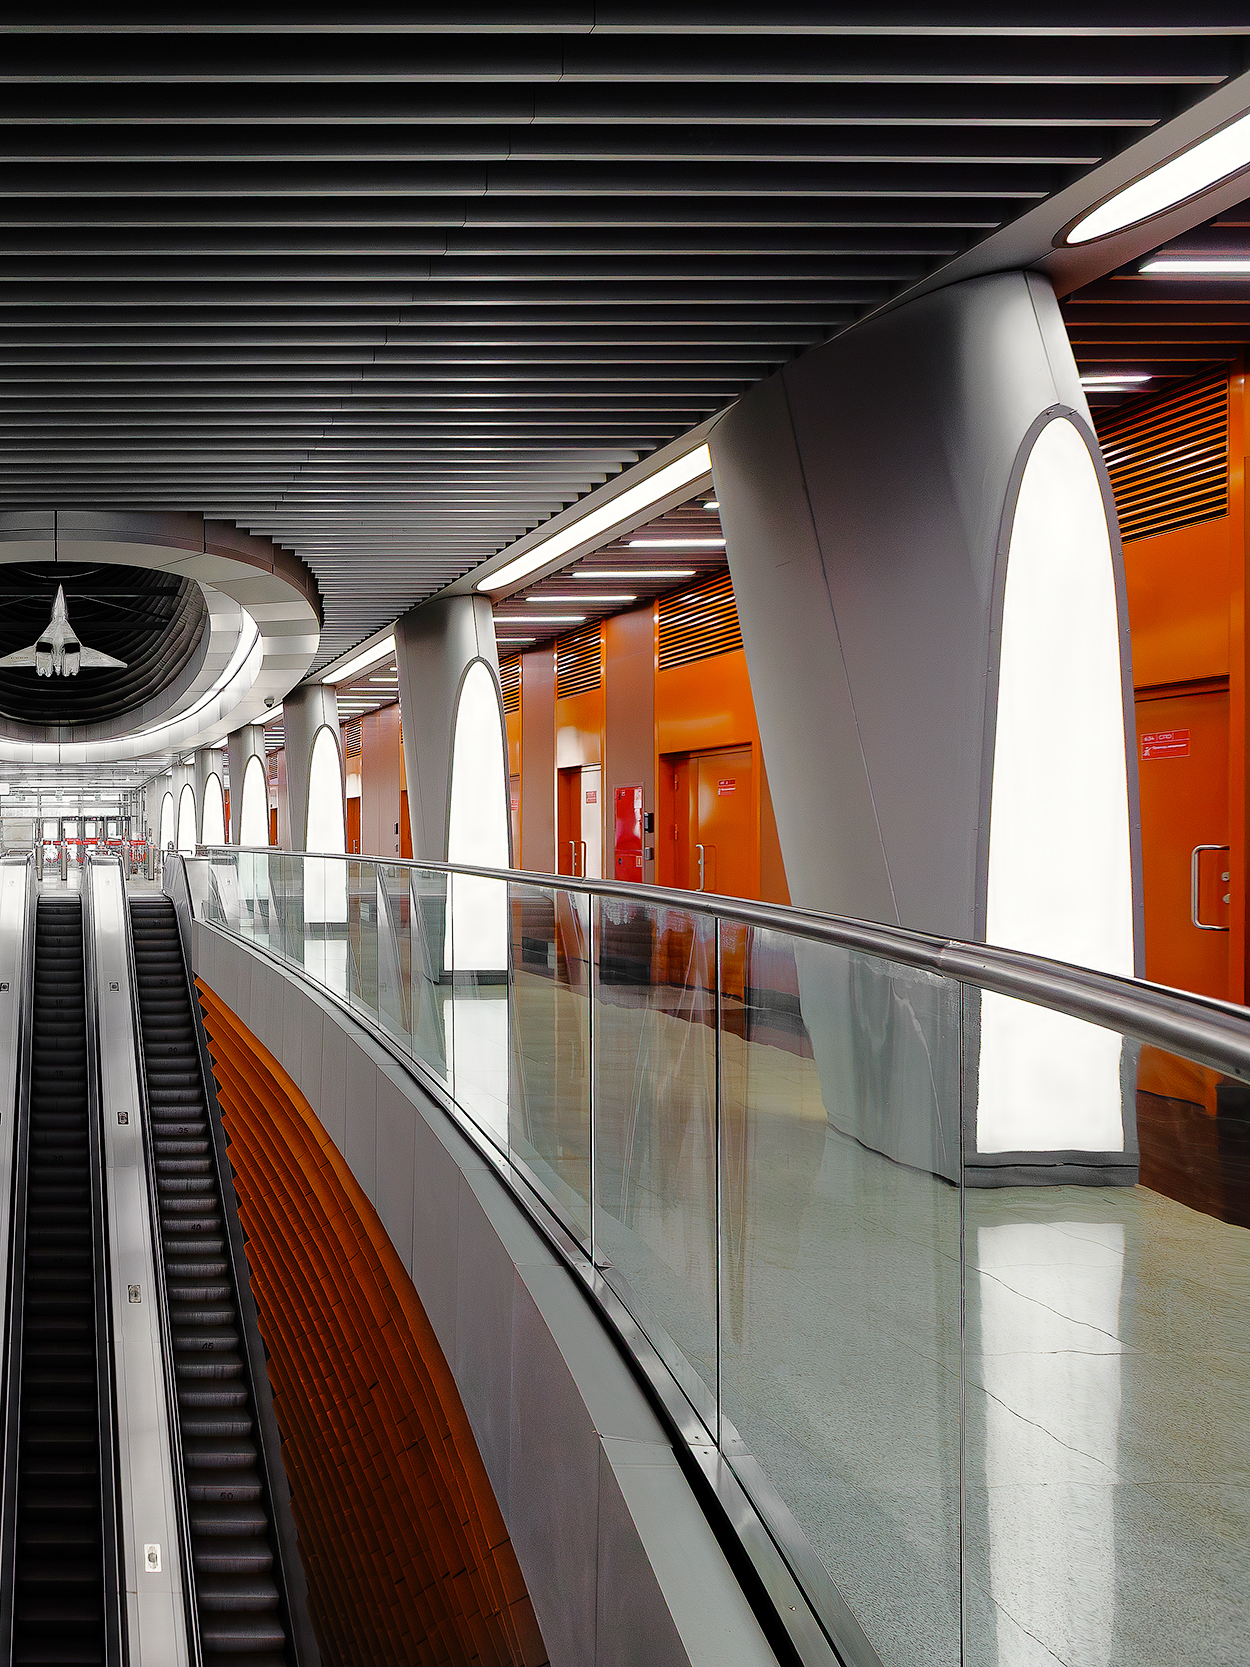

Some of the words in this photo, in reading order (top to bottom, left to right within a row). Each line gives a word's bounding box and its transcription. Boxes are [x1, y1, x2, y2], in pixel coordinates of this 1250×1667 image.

[190, 1223, 202, 1231] 40
[202, 1342, 214, 1350] 45
[220, 1492, 234, 1500] 50
